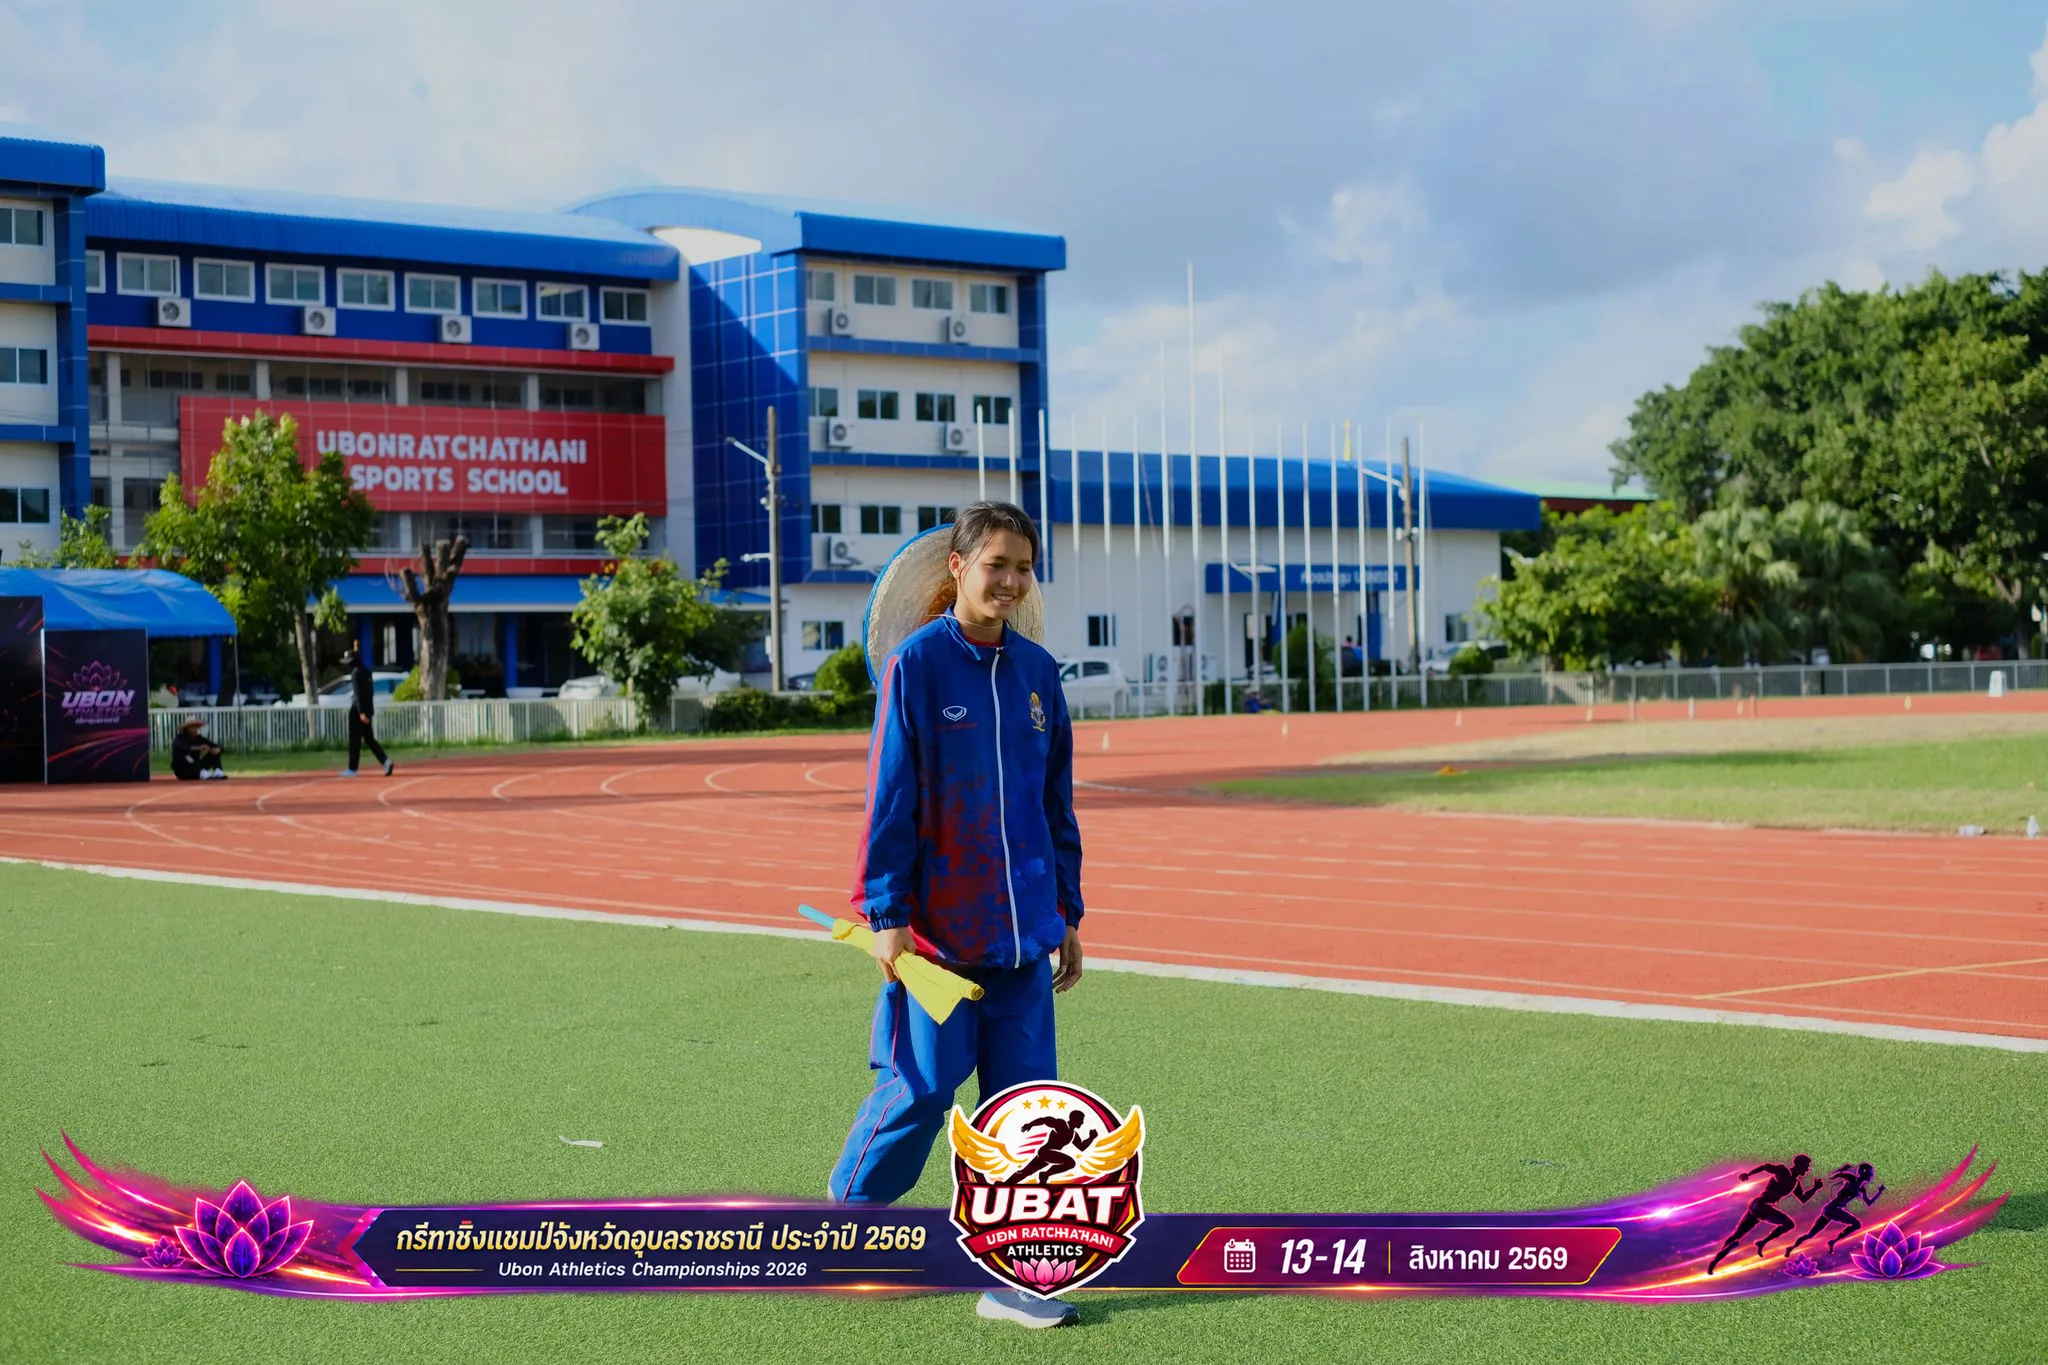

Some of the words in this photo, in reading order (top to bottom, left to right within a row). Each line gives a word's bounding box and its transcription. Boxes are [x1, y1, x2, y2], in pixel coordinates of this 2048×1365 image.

[316, 430, 587, 464] UBONRATCHATHANI
[350, 464, 454, 492] SPORTS
[467, 467, 568, 495] SCHOOL
[61, 690, 136, 708] UBON
